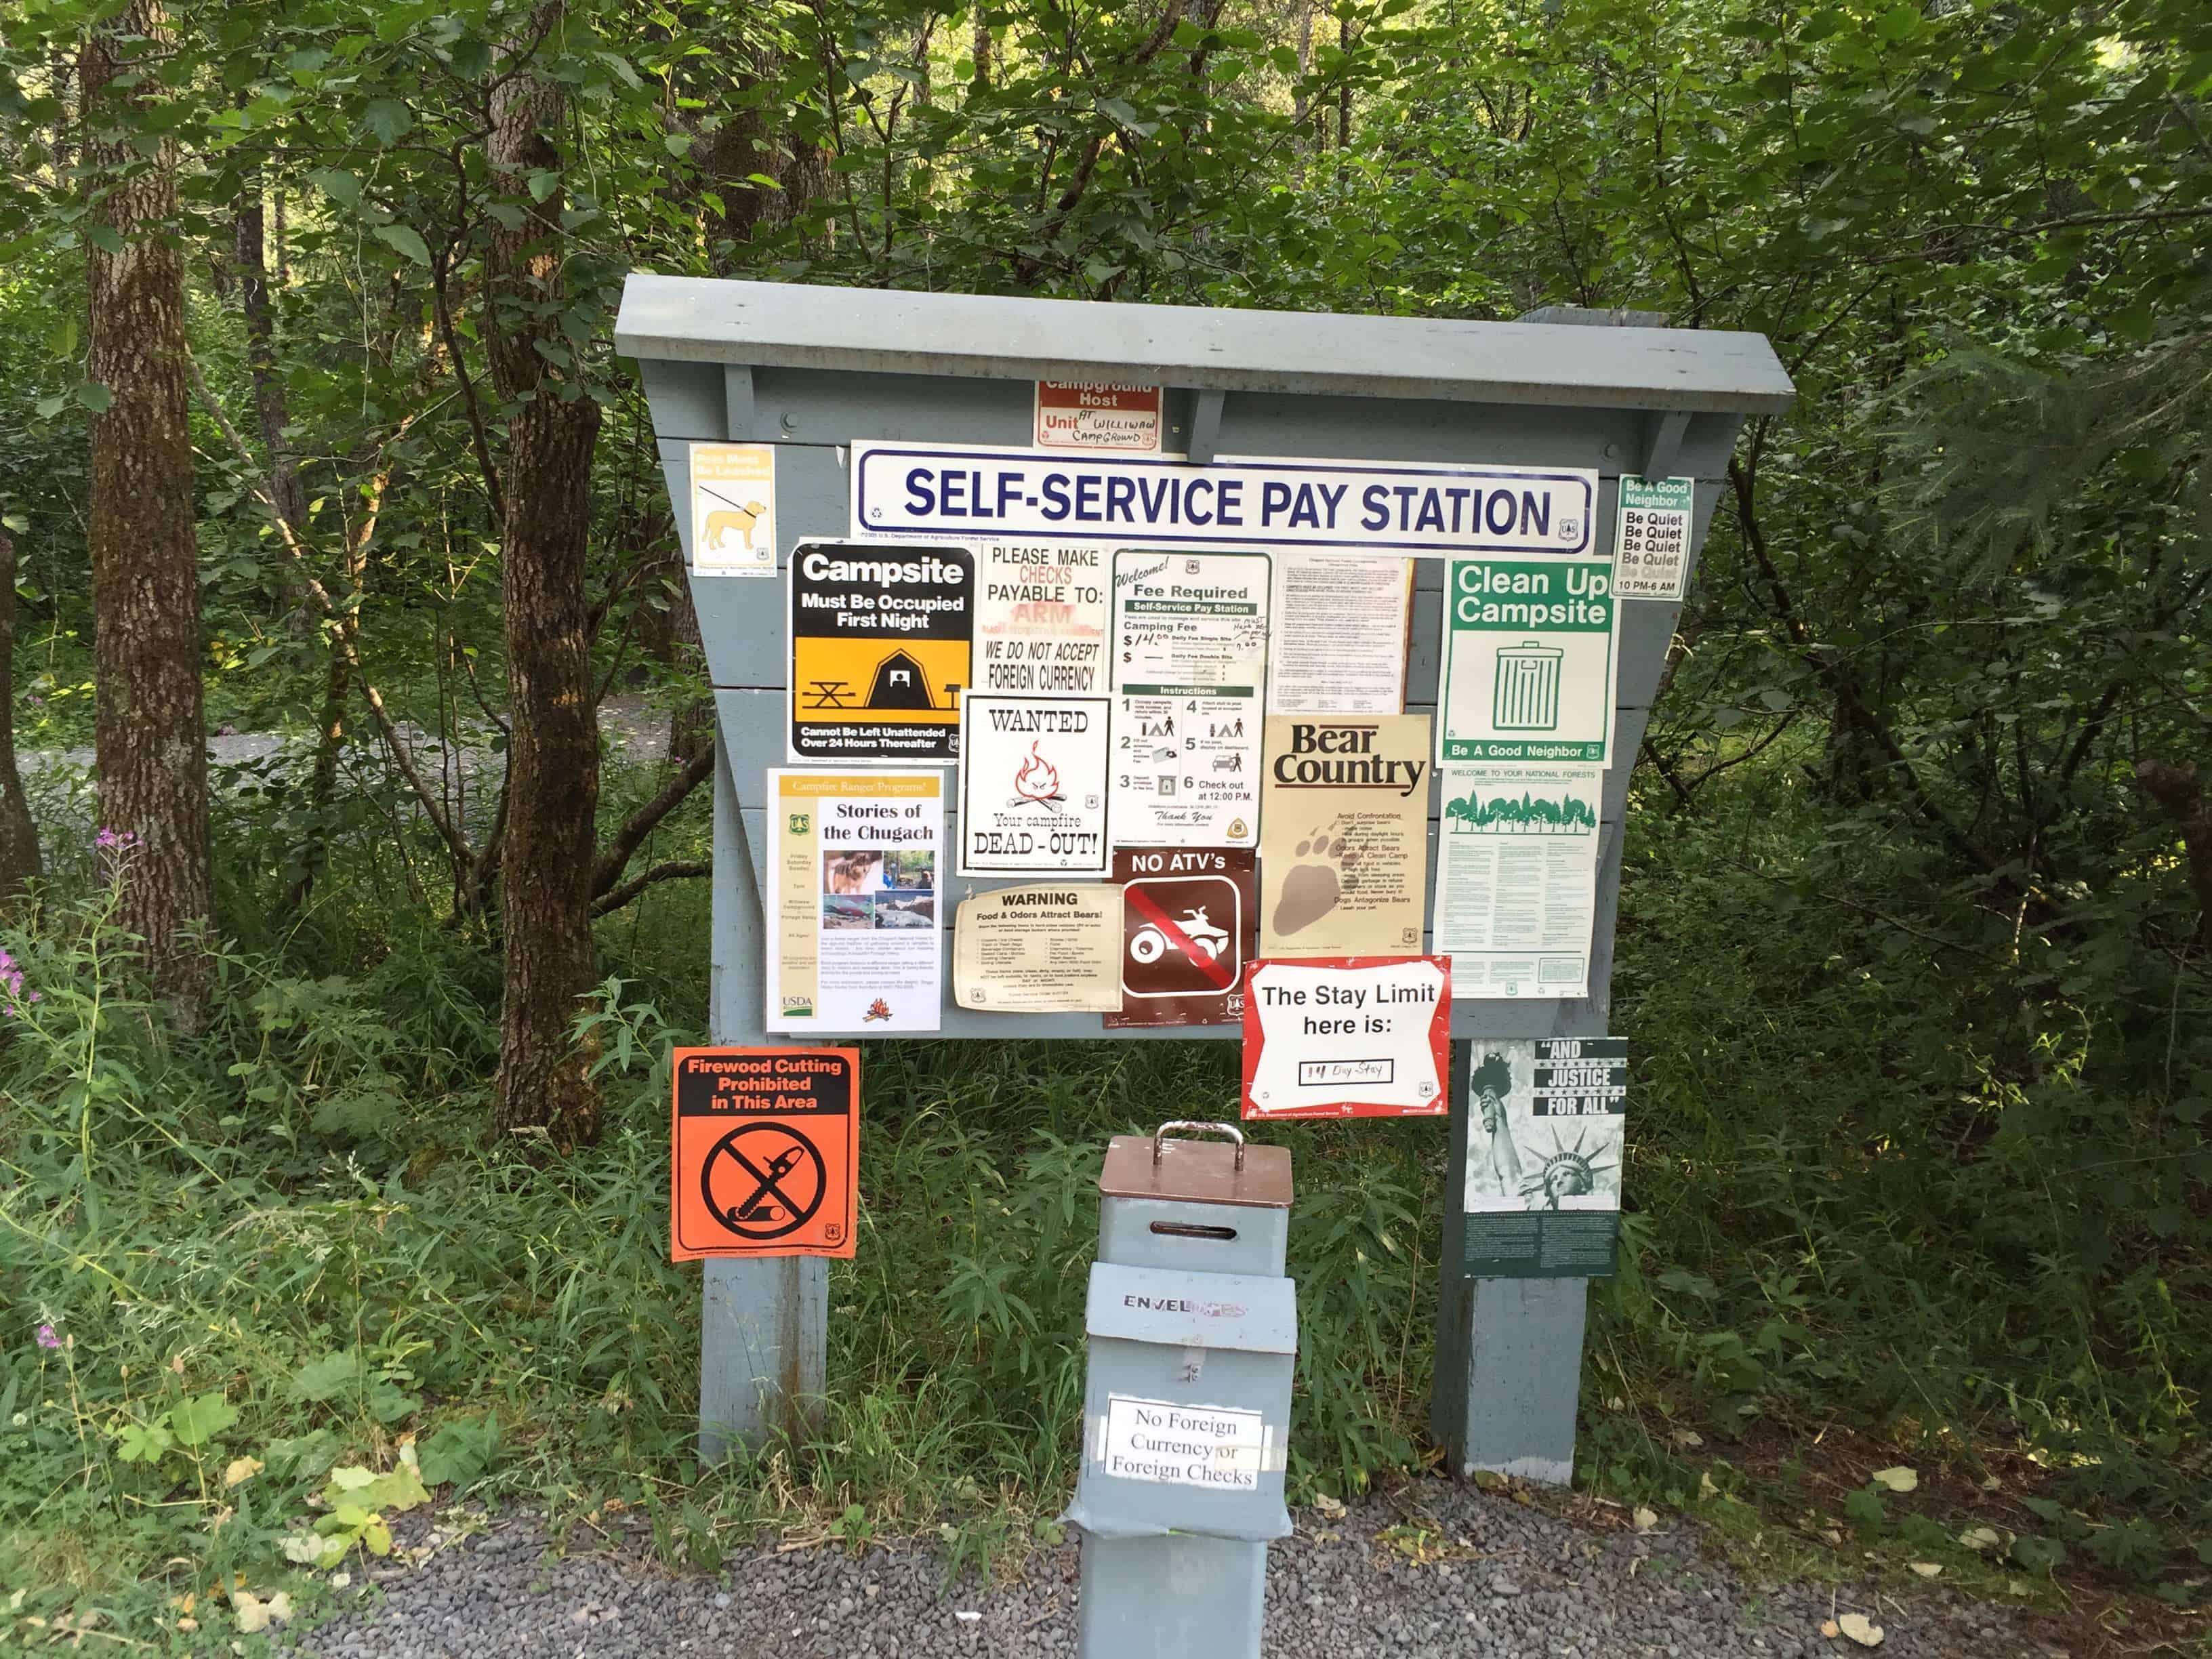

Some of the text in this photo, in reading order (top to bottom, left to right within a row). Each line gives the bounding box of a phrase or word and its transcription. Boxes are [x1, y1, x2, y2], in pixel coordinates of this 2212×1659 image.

[1080, 393, 1118, 407] Host
[1046, 415, 1079, 429] Unit
[1079, 410, 1096, 421] AT
[1626, 480, 1687, 494] Be A Good
[904, 468, 1552, 537] SELF-SERVICE PAY STATION
[1625, 493, 1678, 508] Neighbor
[1626, 512, 1683, 527] Be Quiet
[1625, 525, 1682, 540] Be Quiet
[1624, 539, 1681, 553] Be Quiet
[992, 547, 1099, 567] PLEASE MAKE
[1622, 552, 1679, 567] Be Quiet
[802, 553, 964, 588] Campsite
[1019, 565, 1072, 585] CHECKS
[1115, 555, 1170, 588] Welcome!
[1458, 565, 1608, 600] Clean Up
[1619, 581, 1676, 592] 10 PM-6 AM
[987, 584, 1103, 604] PAYABLE TO:
[1133, 584, 1248, 600] Fee Required
[802, 593, 964, 613] Must Be Occupied
[1134, 602, 1248, 615] Self-Service Pay Station
[1014, 603, 1073, 624] ARM
[1457, 596, 1607, 628] Campsite
[837, 612, 930, 632] First Night
[1124, 621, 1197, 632] Camping Fee
[1124, 635, 1132, 646] $
[986, 640, 1100, 661] WE DO NOT ACCEPT
[1123, 652, 1132, 663] $
[989, 663, 1095, 691] FOREIGN CURRENCY
[1160, 687, 1217, 695] Instructions
[1122, 698, 1130, 712] 1
[1187, 700, 1197, 713] 4
[989, 709, 1088, 733] WANTED
[800, 726, 945, 737] Cannot Be Left Unattended
[1291, 724, 1376, 754] Bear
[801, 738, 937, 749] Over 24 Hours Thereafter
[1120, 736, 1131, 749] 2
[1185, 737, 1196, 750] 5
[1452, 745, 1583, 760] Be A Good Neighbor
[1120, 775, 1130, 787] 3
[1183, 776, 1193, 789] 6
[1273, 754, 1427, 798] Country
[840, 781, 874, 794] Ranger
[1199, 781, 1244, 790] Check out
[1198, 792, 1253, 801] at 12:00 P.M.
[837, 804, 922, 818] Stories of
[1155, 811, 1214, 823] Thank You
[993, 813, 1082, 832] Your campfire
[824, 825, 933, 843] the Chugach
[1132, 853, 1225, 872] NO ATV's
[1002, 893, 1078, 906] WARNING
[977, 912, 998, 920] Food
[1010, 911, 1038, 919] Odors
[1040, 911, 1070, 919] Attract
[1073, 911, 1102, 919] Bears!
[783, 996, 813, 1006] USDA
[1262, 983, 1435, 1008] The Stay Limit
[1304, 1015, 1391, 1035] here is:
[689, 1059, 842, 1076] Firewood Cutting
[718, 1078, 811, 1091] Prohibited
[1548, 1068, 1611, 1086] JUSTICE
[712, 1095, 817, 1109] in This Area
[1547, 1097, 1578, 1115] FOR
[1136, 1409, 1237, 1436] No Foreign
[1130, 1433, 1238, 1460] Currency or
[1112, 1456, 1252, 1485] Foreign Checks
